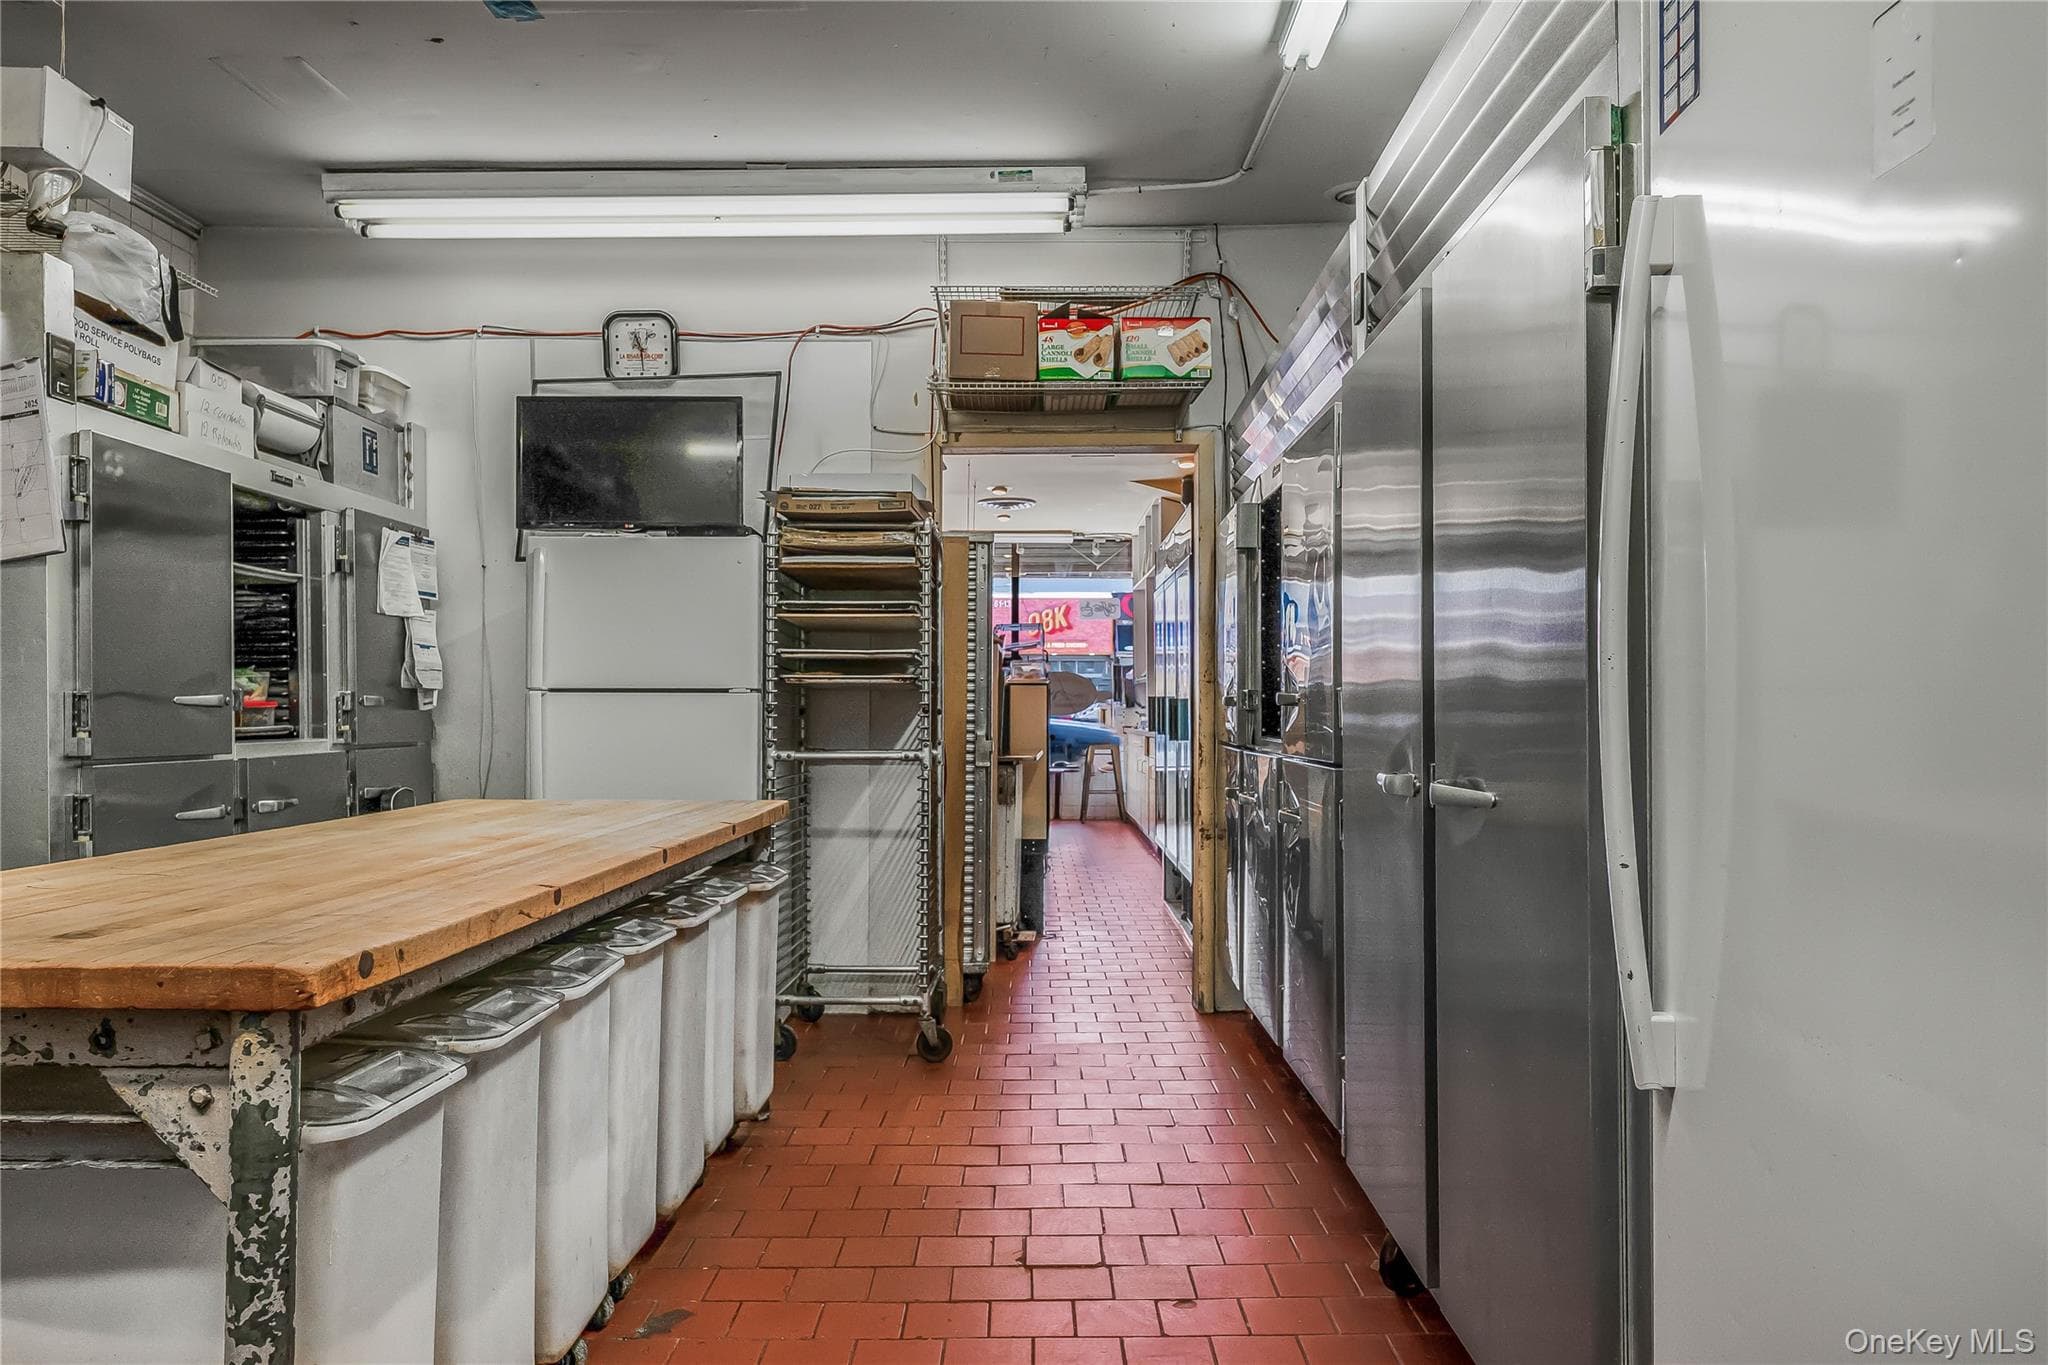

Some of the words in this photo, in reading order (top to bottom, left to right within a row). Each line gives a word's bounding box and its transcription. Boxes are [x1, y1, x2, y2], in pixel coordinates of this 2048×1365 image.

[74, 316, 89, 331] OOD
[91, 326, 122, 348] SERVICE
[124, 341, 161, 366] POLYBAGS
[80, 332, 99, 349] ROLL
[24, 399, 39, 409] 2025
